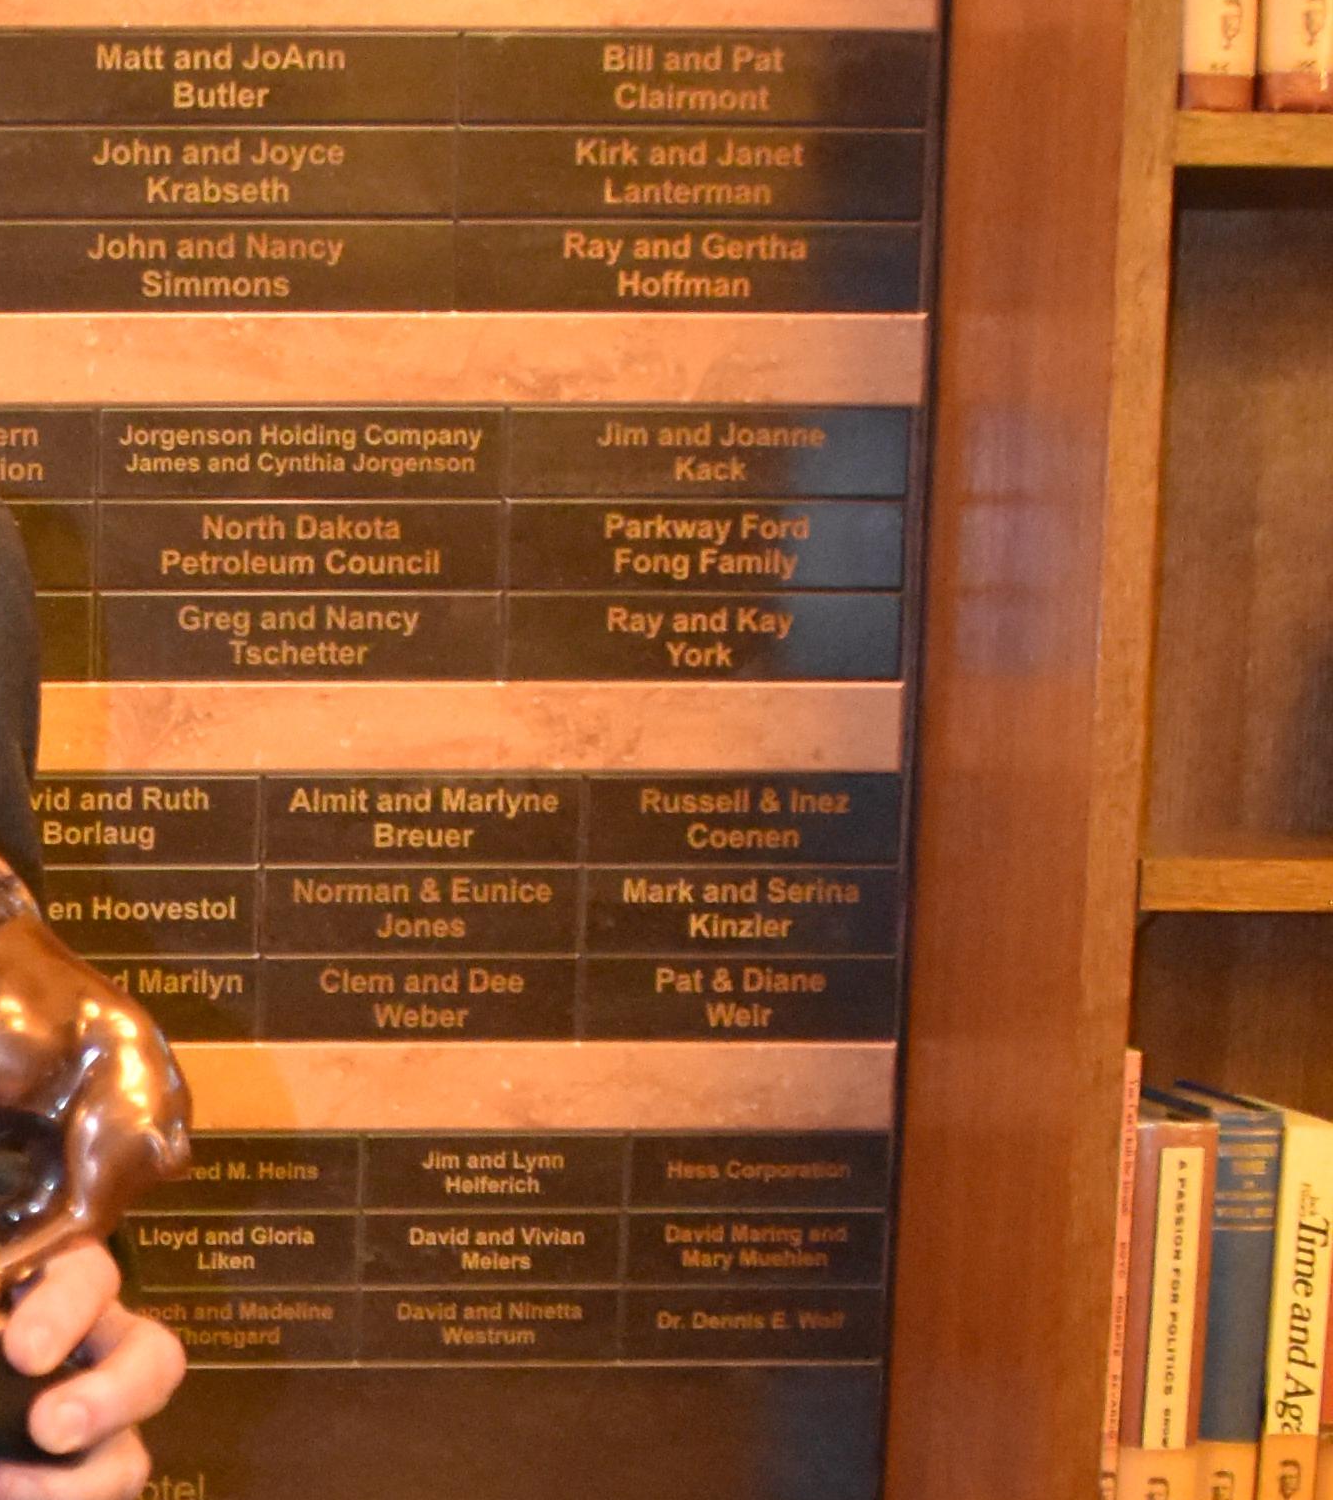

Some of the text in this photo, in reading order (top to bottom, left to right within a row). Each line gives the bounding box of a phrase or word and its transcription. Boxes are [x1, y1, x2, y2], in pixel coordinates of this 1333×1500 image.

[96, 43, 346, 71] Matt and JoAnn
[173, 80, 270, 109] Butler
[202, 513, 401, 541] North Dakota
[161, 548, 440, 575] Petroleum Council
[42, 820, 155, 851] Borlaug
[92, 895, 236, 921] Hoovestol
[1172, 1176, 1188, 1263] PASSION
[139, 1225, 315, 1250] Lloyd and Gloria
[409, 1226, 585, 1246] David and Vivian
[1293, 1217, 1330, 1298] Time
[1170, 1267, 1182, 1306] FOR
[1287, 1302, 1317, 1370] and
[1162, 1311, 1180, 1397] POLITICS
